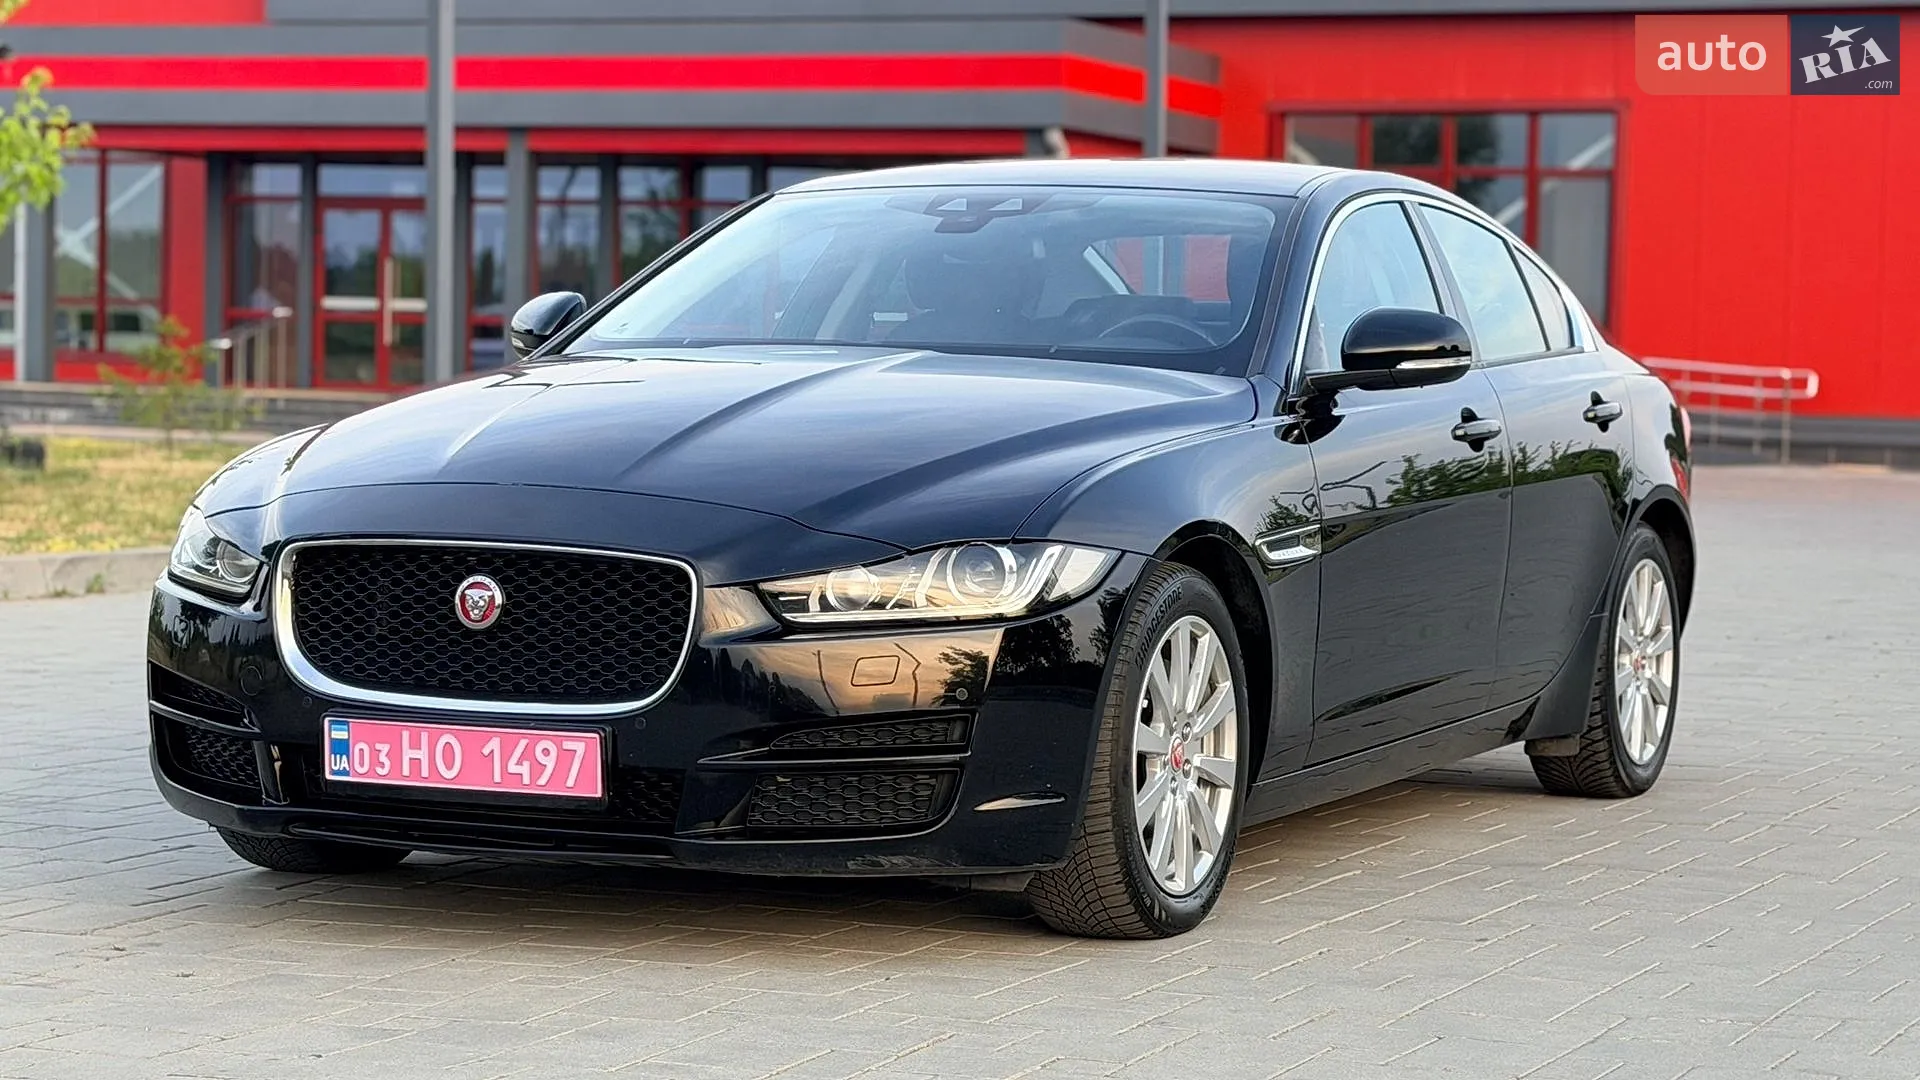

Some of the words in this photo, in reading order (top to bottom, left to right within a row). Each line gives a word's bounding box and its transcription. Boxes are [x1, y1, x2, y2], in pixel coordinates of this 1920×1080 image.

[331, 753, 349, 771] UA
[353, 741, 390, 776] 03
[401, 730, 463, 780] HO
[481, 736, 586, 788] 1497
